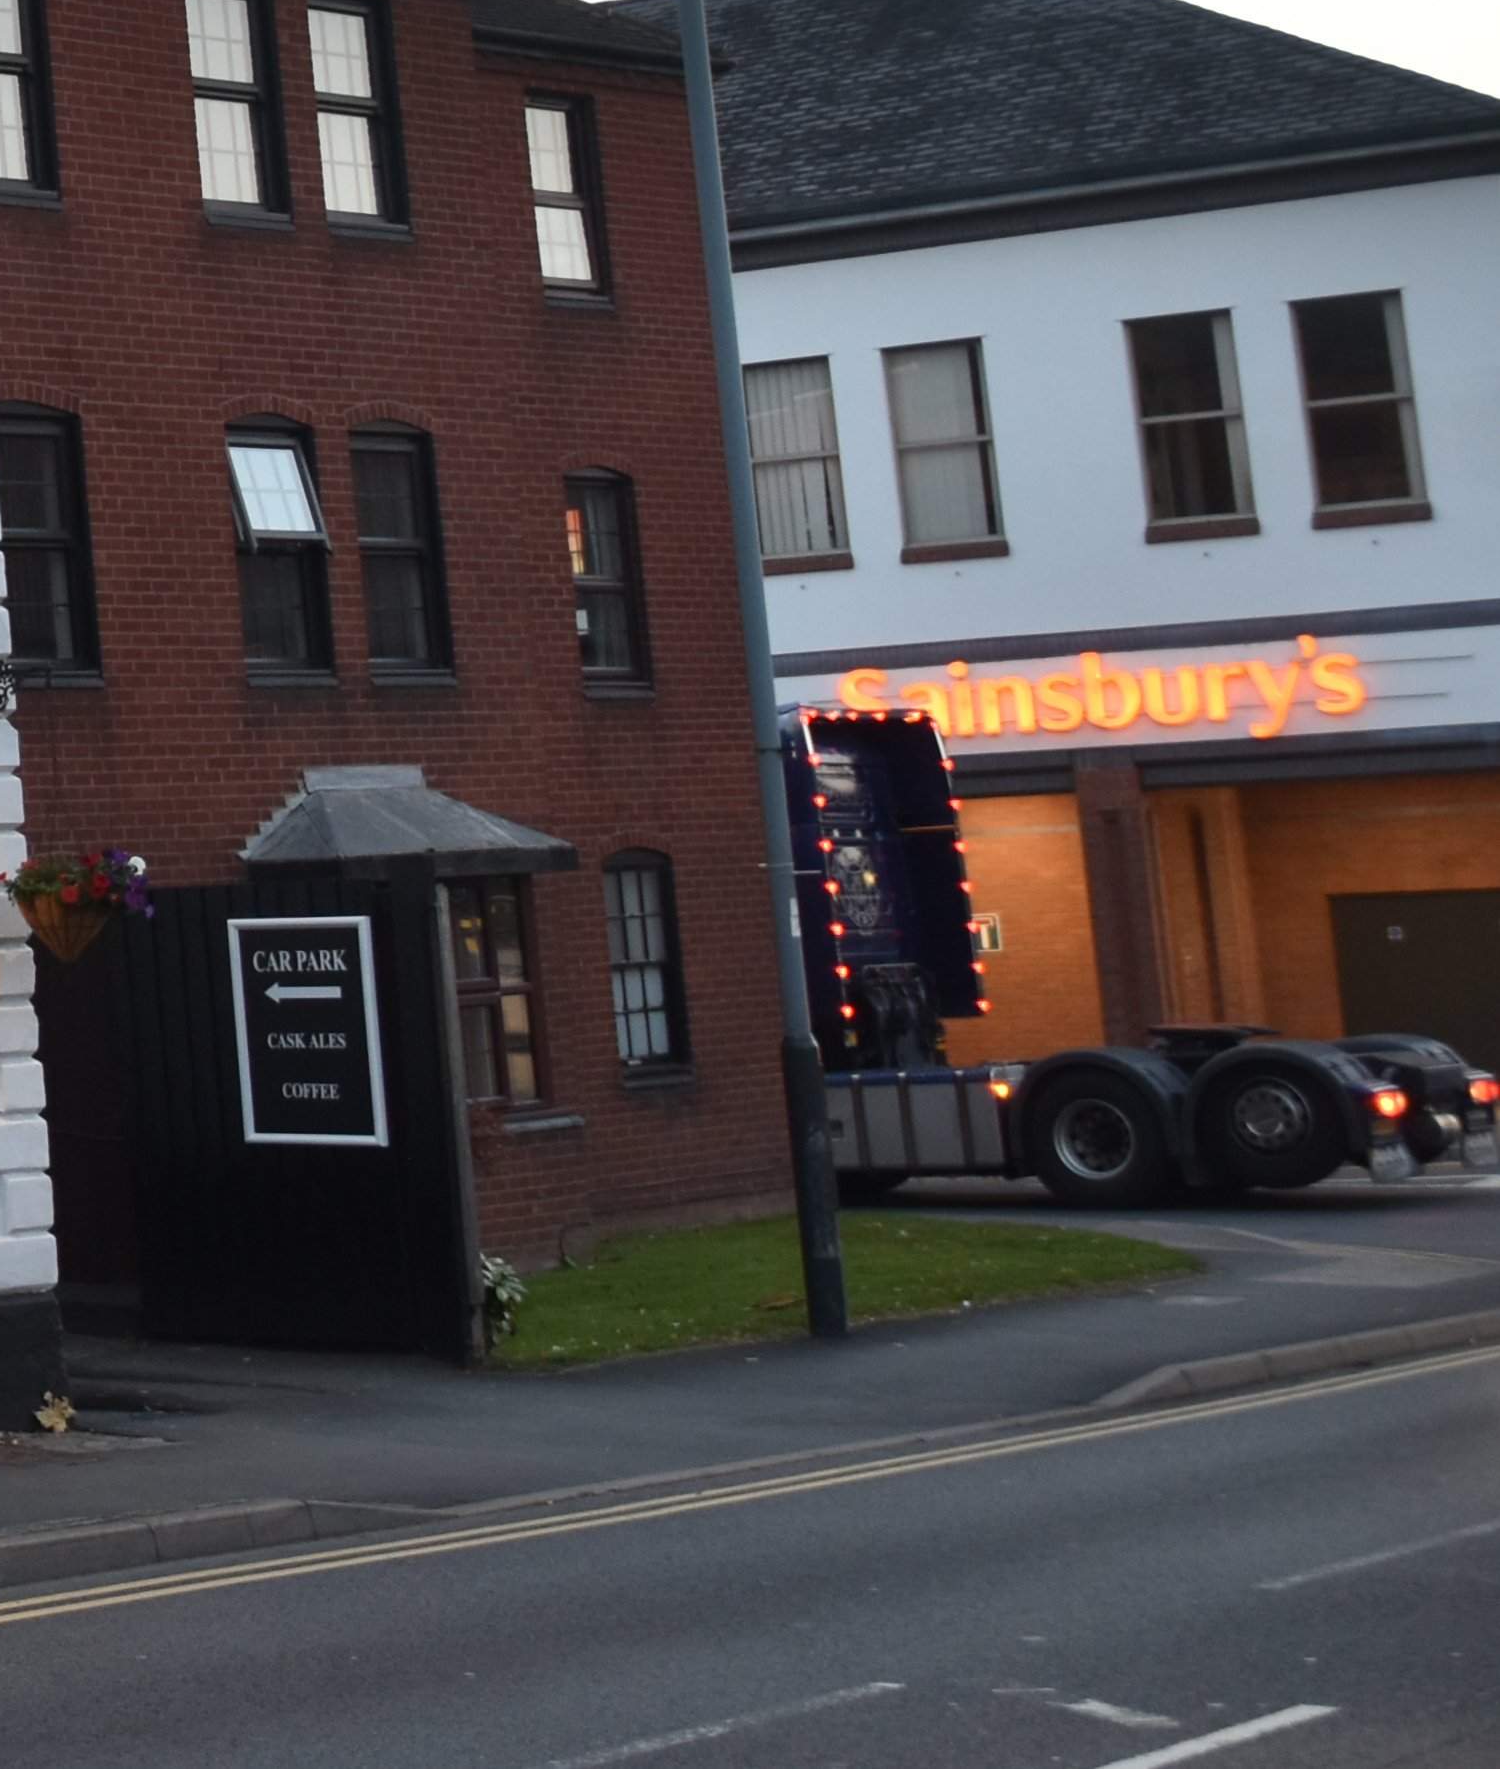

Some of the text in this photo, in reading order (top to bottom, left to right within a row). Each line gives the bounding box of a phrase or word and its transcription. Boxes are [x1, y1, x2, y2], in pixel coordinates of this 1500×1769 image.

[252, 949, 348, 972] CAR PARK
[267, 1033, 347, 1049] CASK ALES
[282, 1082, 340, 1099] COFFEE
